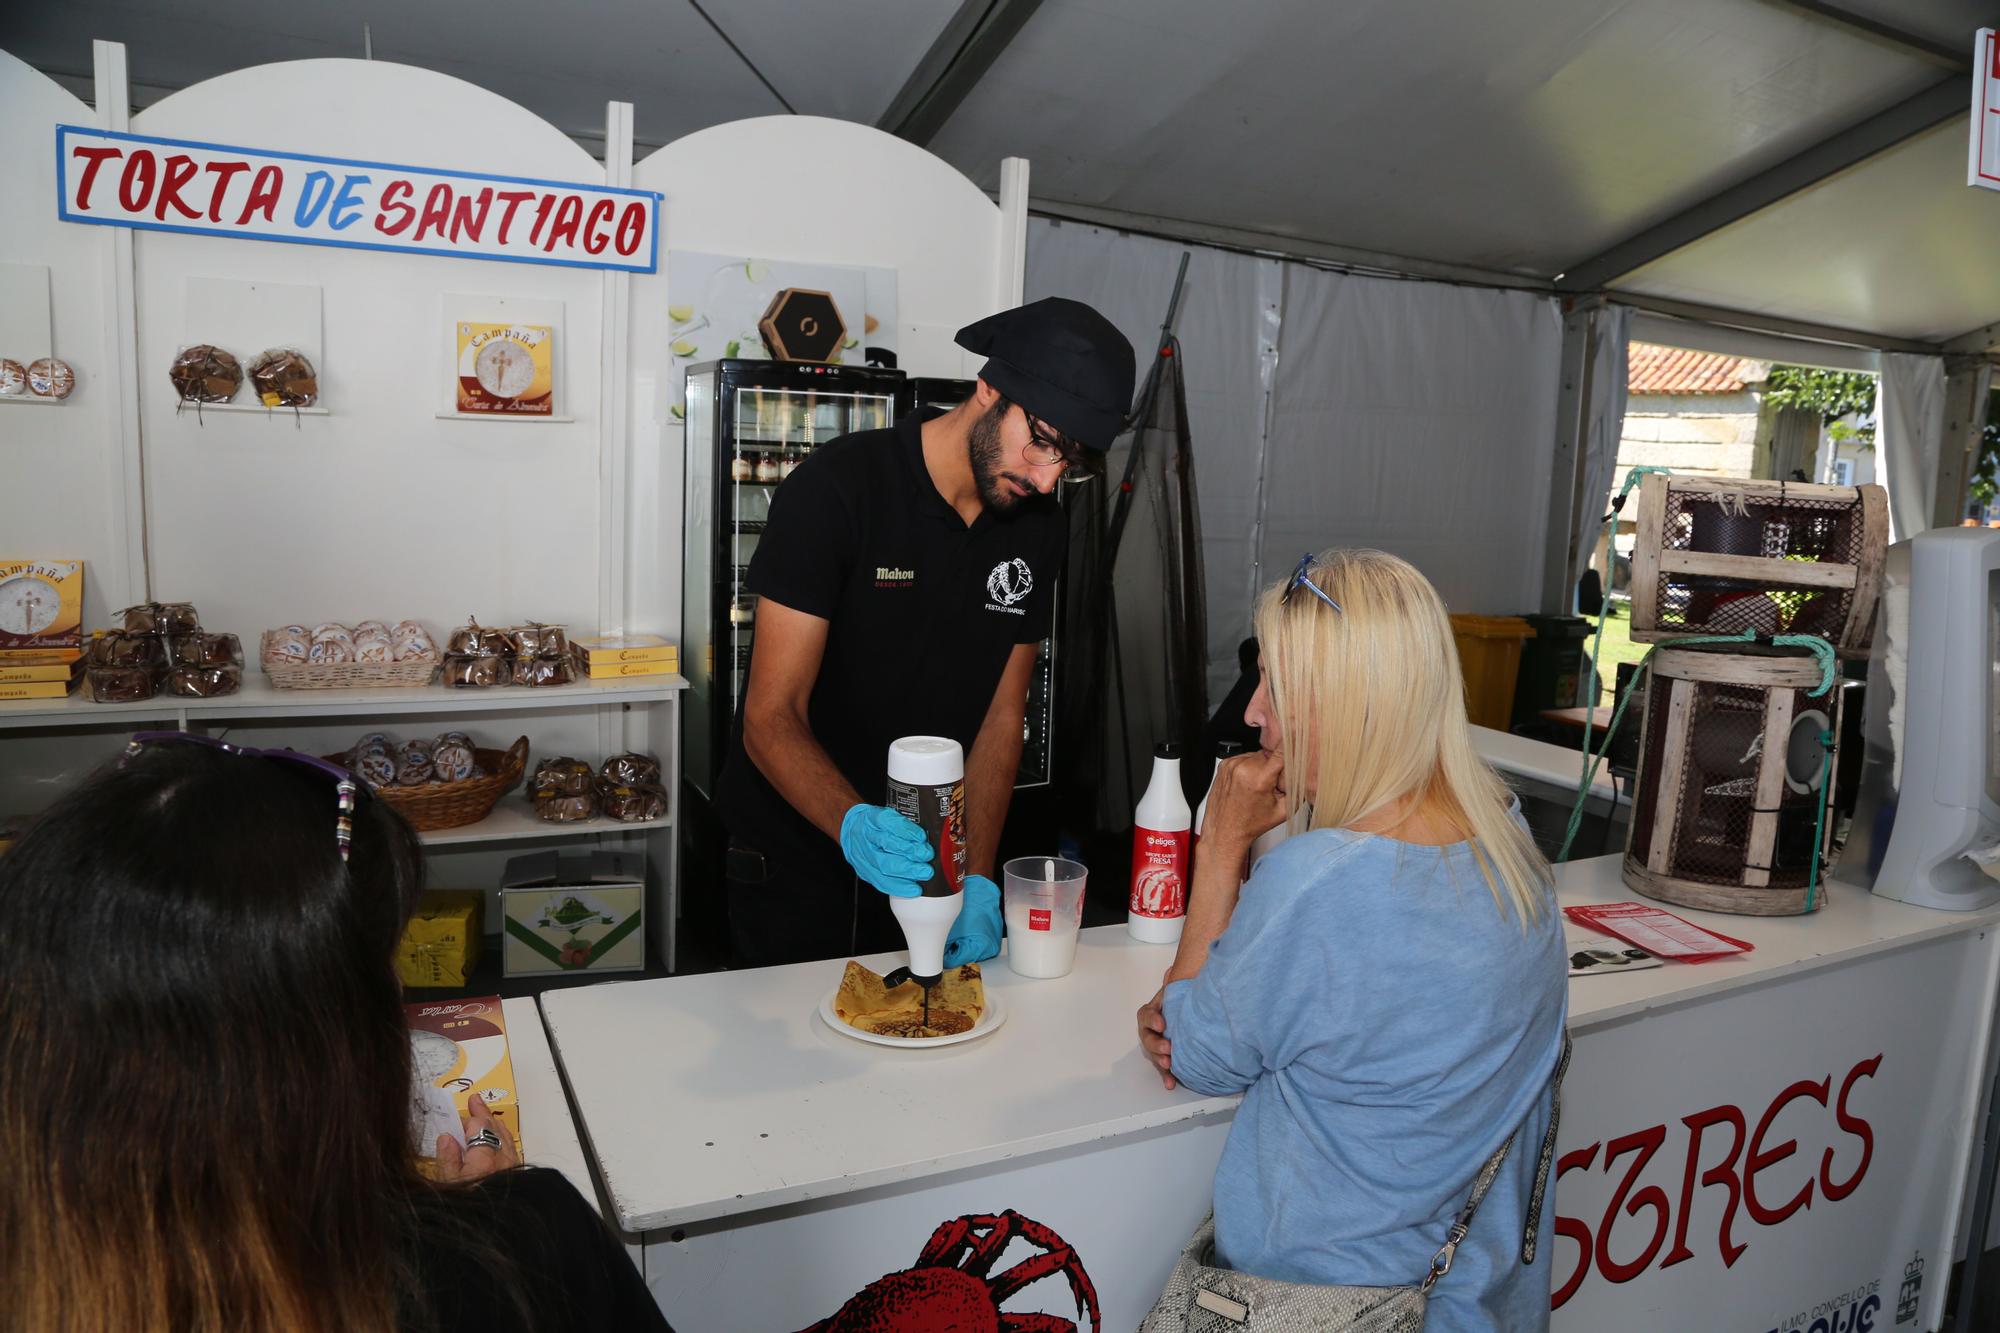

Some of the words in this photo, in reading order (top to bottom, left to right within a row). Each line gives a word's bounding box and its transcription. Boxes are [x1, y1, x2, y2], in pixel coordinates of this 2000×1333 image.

[73, 146, 284, 225] TORTA
[294, 170, 372, 231] DE
[374, 180, 646, 256] SANTIAGO
[471, 328, 537, 349] Campaña
[0, 563, 64, 584] ampaña
[876, 567, 915, 580] Mahou
[985, 603, 1001, 611] FESTA
[0, 689, 28, 698] ampaña
[1155, 837, 1176, 847] eliges
[1149, 856, 1172, 865] FRESA
[1551, 1052, 1883, 1311] STRES
[1811, 1286, 1865, 1318] CONCELLO
[1866, 1279, 1881, 1296] DE
